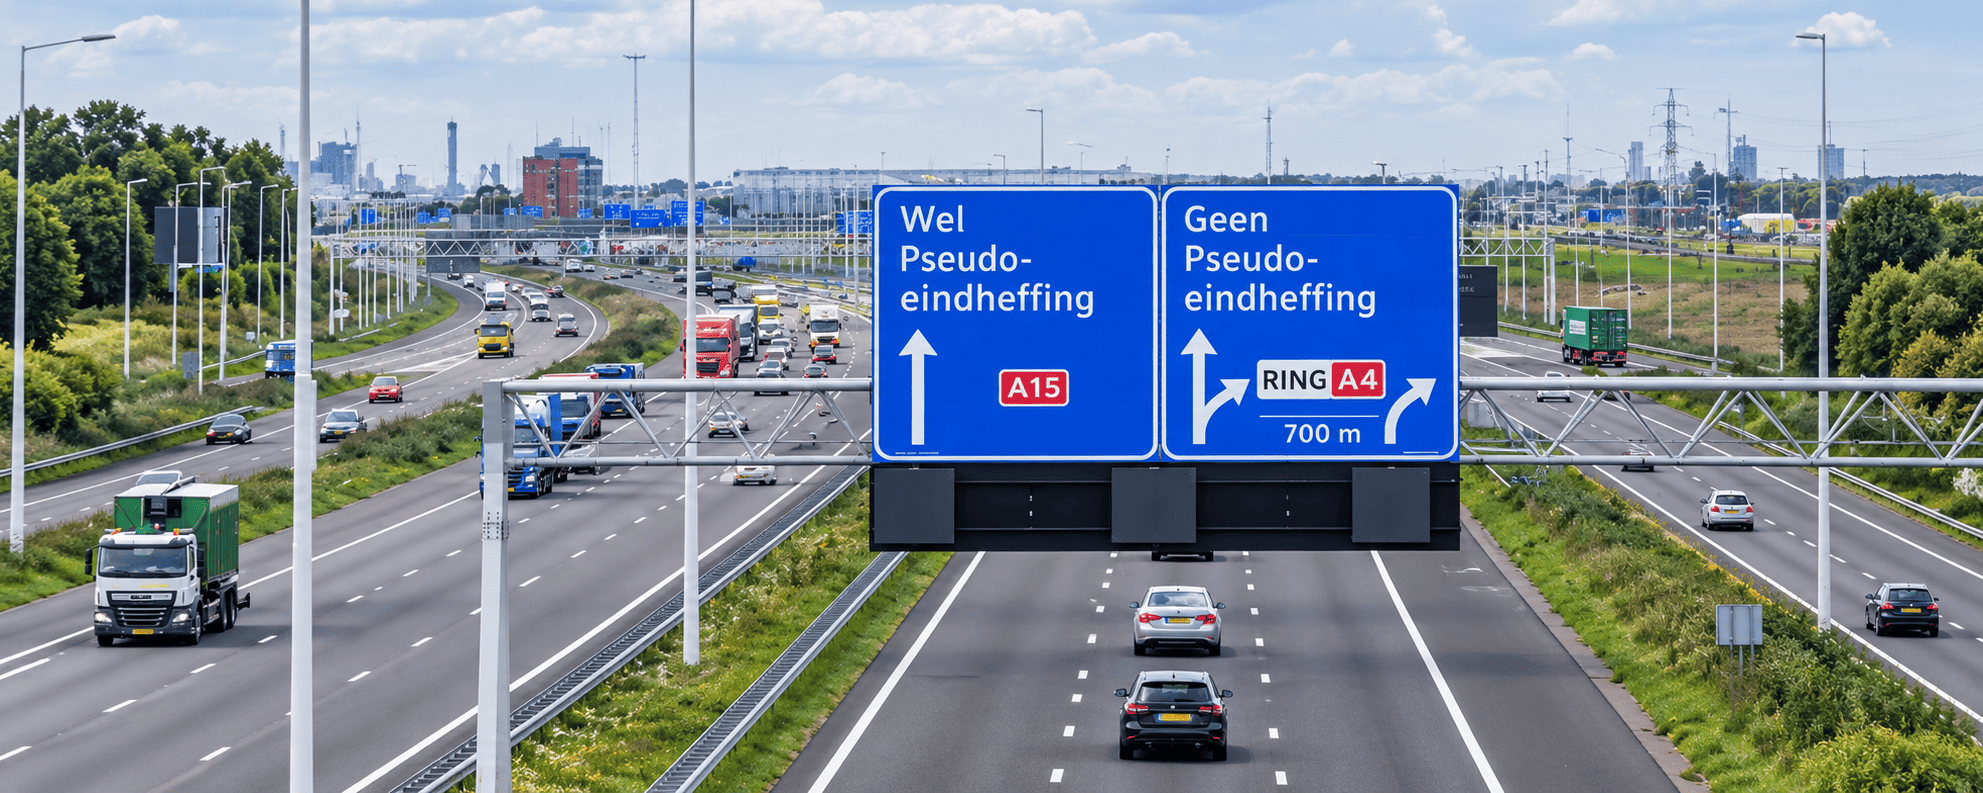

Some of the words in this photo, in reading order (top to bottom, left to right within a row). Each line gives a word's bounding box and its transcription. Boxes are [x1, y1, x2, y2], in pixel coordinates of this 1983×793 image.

[900, 204, 965, 233] Wel
[1184, 204, 1268, 233] Geen
[900, 243, 1032, 273] Pseudo-
[1184, 243, 1318, 273] Pseudo-
[900, 282, 1095, 319] eindheffing
[1184, 282, 1377, 319] eindheffing
[1007, 376, 1061, 399] A15
[1262, 369, 1327, 390] RING
[1337, 368, 1378, 391] A4
[1284, 423, 1330, 444] 700
[1338, 428, 1362, 444] m
